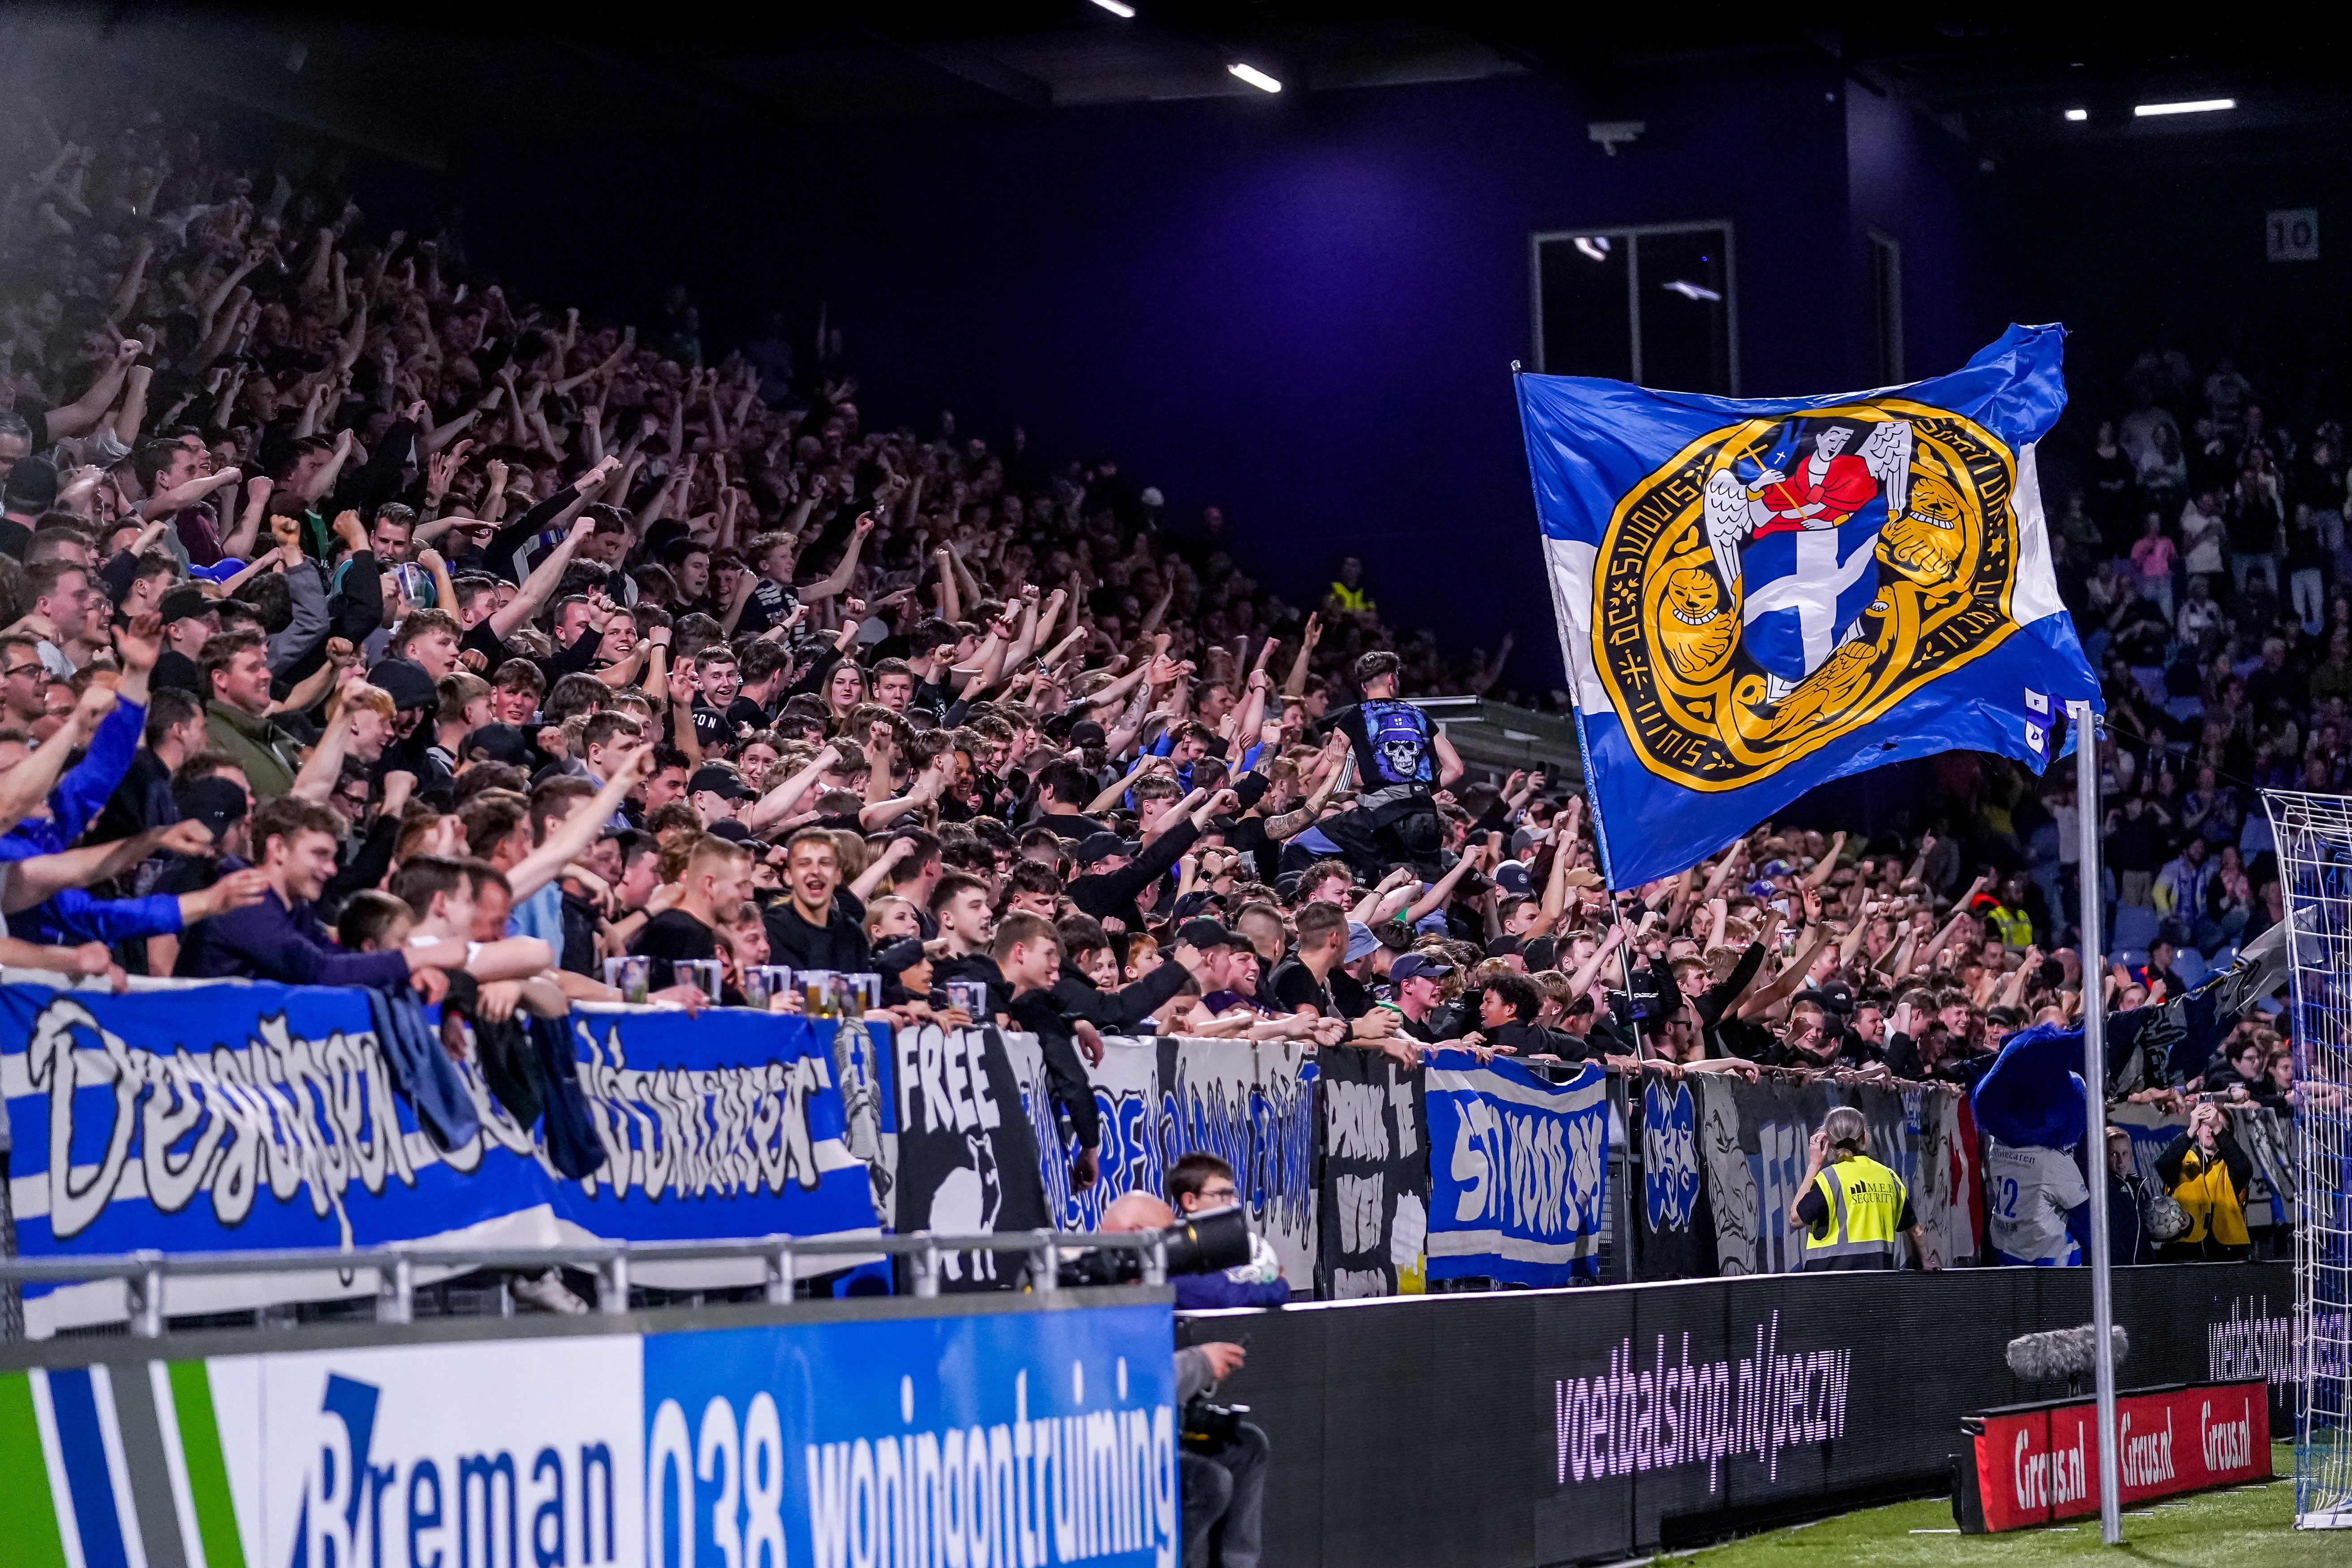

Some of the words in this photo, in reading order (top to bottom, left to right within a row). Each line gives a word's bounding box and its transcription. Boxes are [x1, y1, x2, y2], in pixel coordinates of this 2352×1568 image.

[2273, 219, 2311, 250] 10
[897, 1024, 1000, 1134] FREE
[1852, 1193, 1894, 1205] SECURITY
[1996, 1176, 2018, 1218] 12
[1555, 1310, 1851, 1494] voetbalshop.nl/peczw
[2015, 1421, 2086, 1510] Circus.nl
[2120, 1407, 2175, 1487] Circus.nl
[2202, 1397, 2251, 1472] Circus.nl
[291, 1370, 615, 1568] Breman
